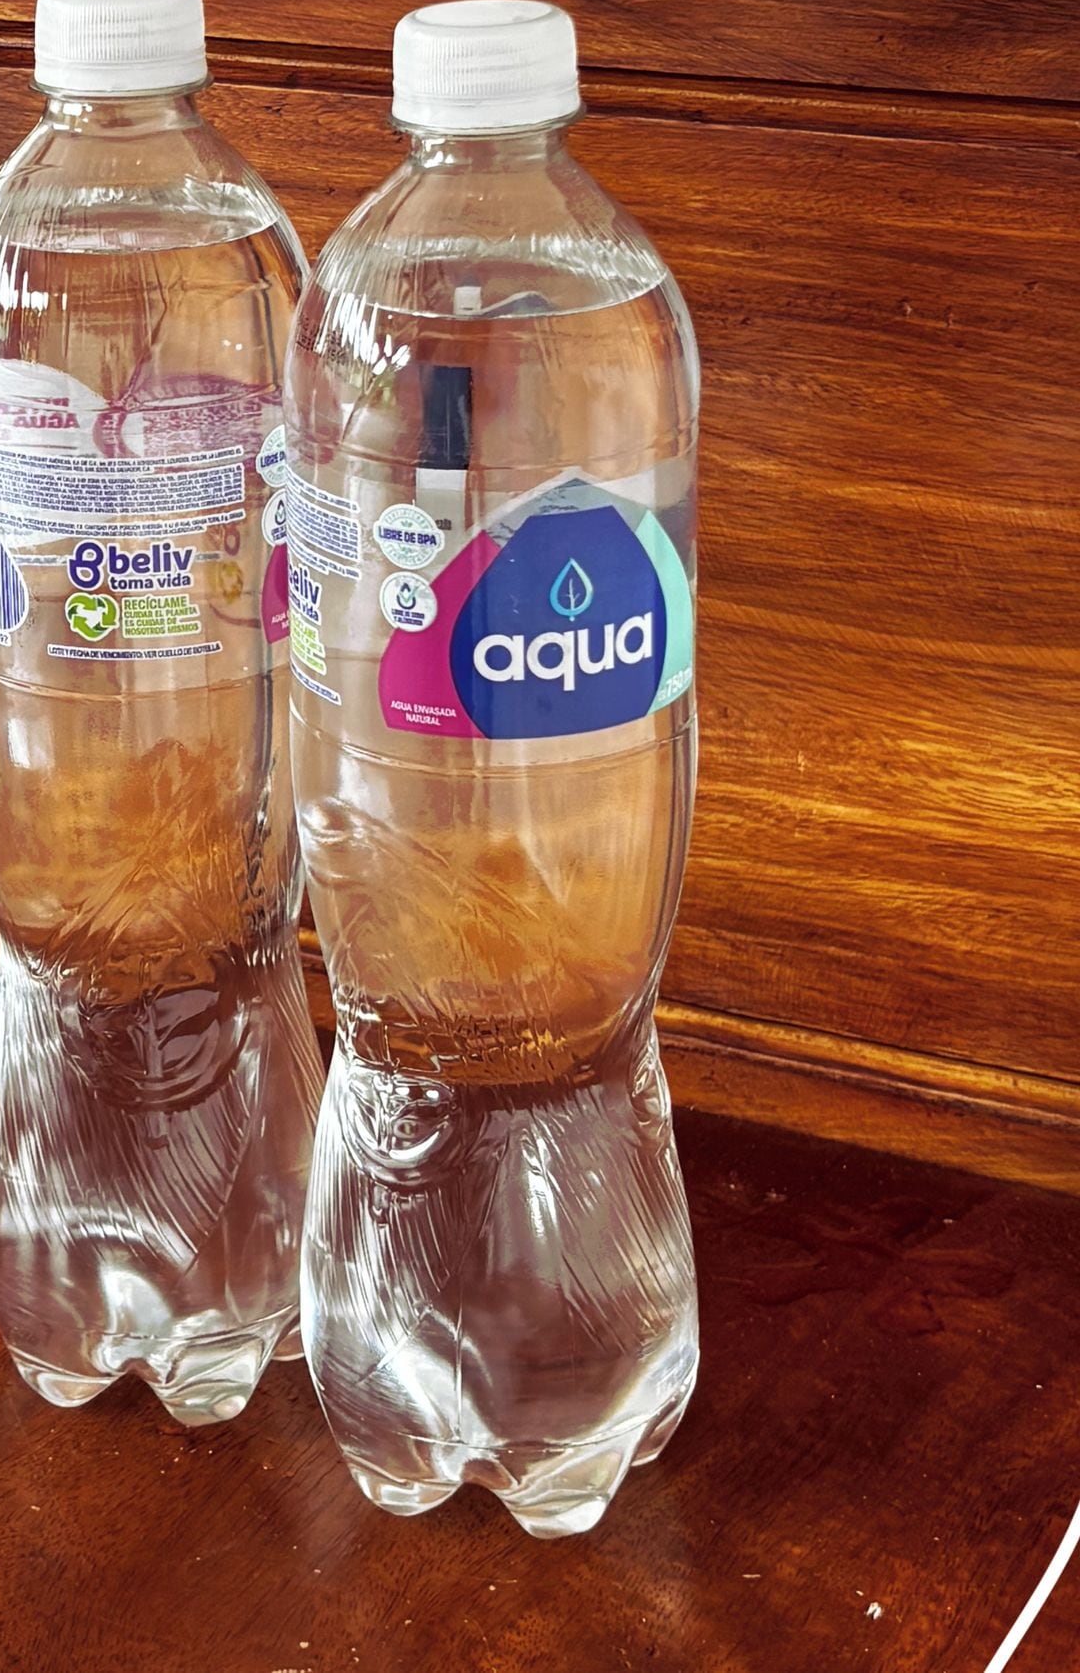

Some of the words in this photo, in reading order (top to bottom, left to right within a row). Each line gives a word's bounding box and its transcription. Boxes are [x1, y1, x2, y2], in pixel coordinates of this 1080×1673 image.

[378, 526, 403, 542] LIBRE
[404, 531, 416, 544] DE
[417, 533, 437, 546] BPA
[108, 542, 193, 575] beliv
[110, 577, 154, 590] toma
[157, 574, 191, 588] vida
[124, 595, 187, 610] RECÍCLAME
[124, 610, 153, 618] CUIDAR
[155, 609, 164, 617] EL
[165, 607, 198, 616] PLANETA
[124, 619, 135, 627] ES
[136, 618, 165, 626] CUIDAR
[124, 627, 166, 636] NOSOTROS
[158, 648, 183, 658] CUELLO
[473, 611, 652, 692] aqua
[391, 700, 412, 712] AGUA
[413, 704, 457, 717] ENVASADA
[405, 713, 441, 726] NATURAL
